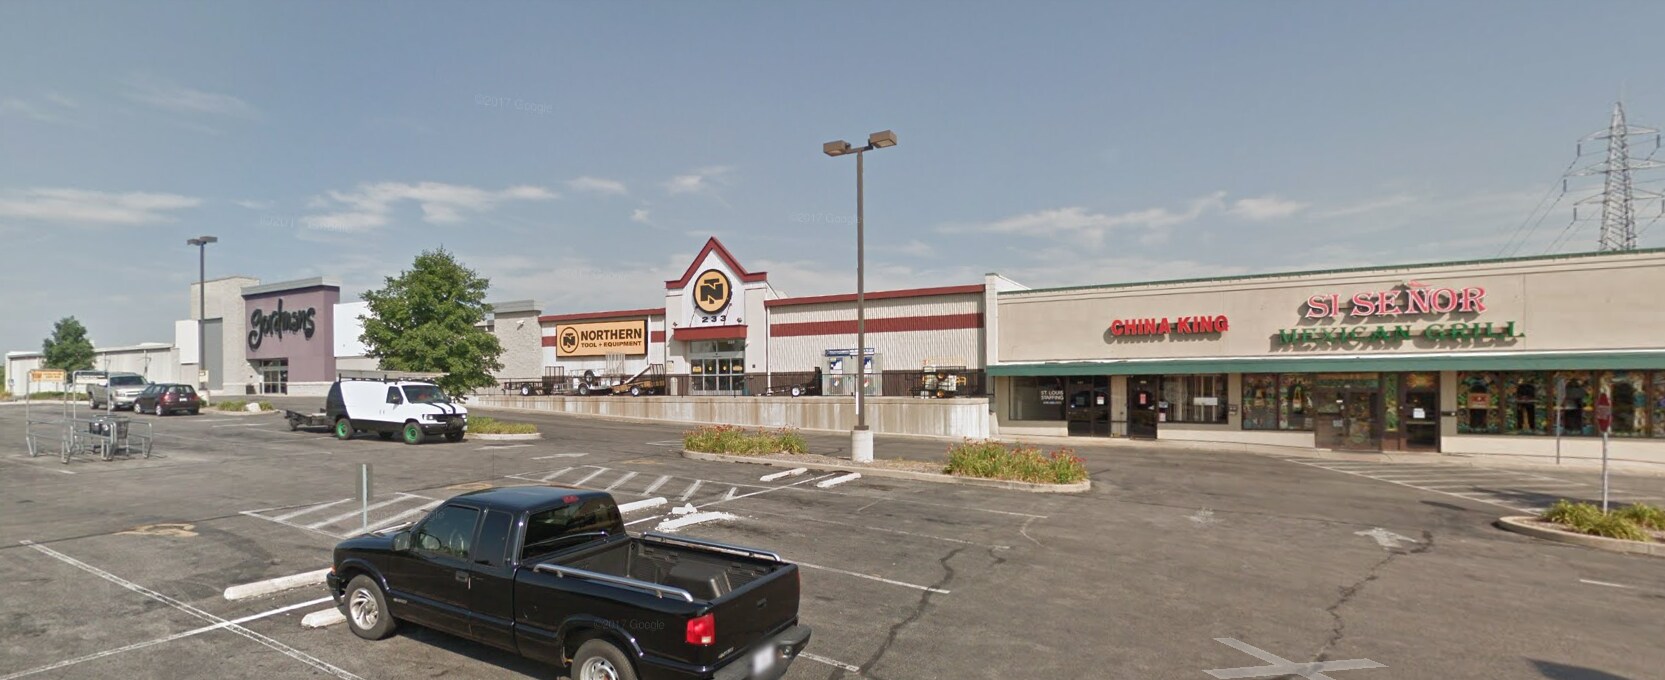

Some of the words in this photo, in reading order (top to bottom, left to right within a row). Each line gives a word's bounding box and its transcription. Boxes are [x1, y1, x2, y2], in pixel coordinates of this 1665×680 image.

[1305, 293, 1340, 318] SI
[1351, 280, 1488, 316] SEÑOR
[248, 298, 316, 352] gordmans
[702, 315, 727, 323] 233
[1110, 317, 1171, 336] CHINA
[1177, 315, 1230, 334] KING
[580, 328, 642, 341] NORTHERN
[1278, 324, 1412, 345] MEXICAN
[1423, 320, 1526, 340] GRILL
